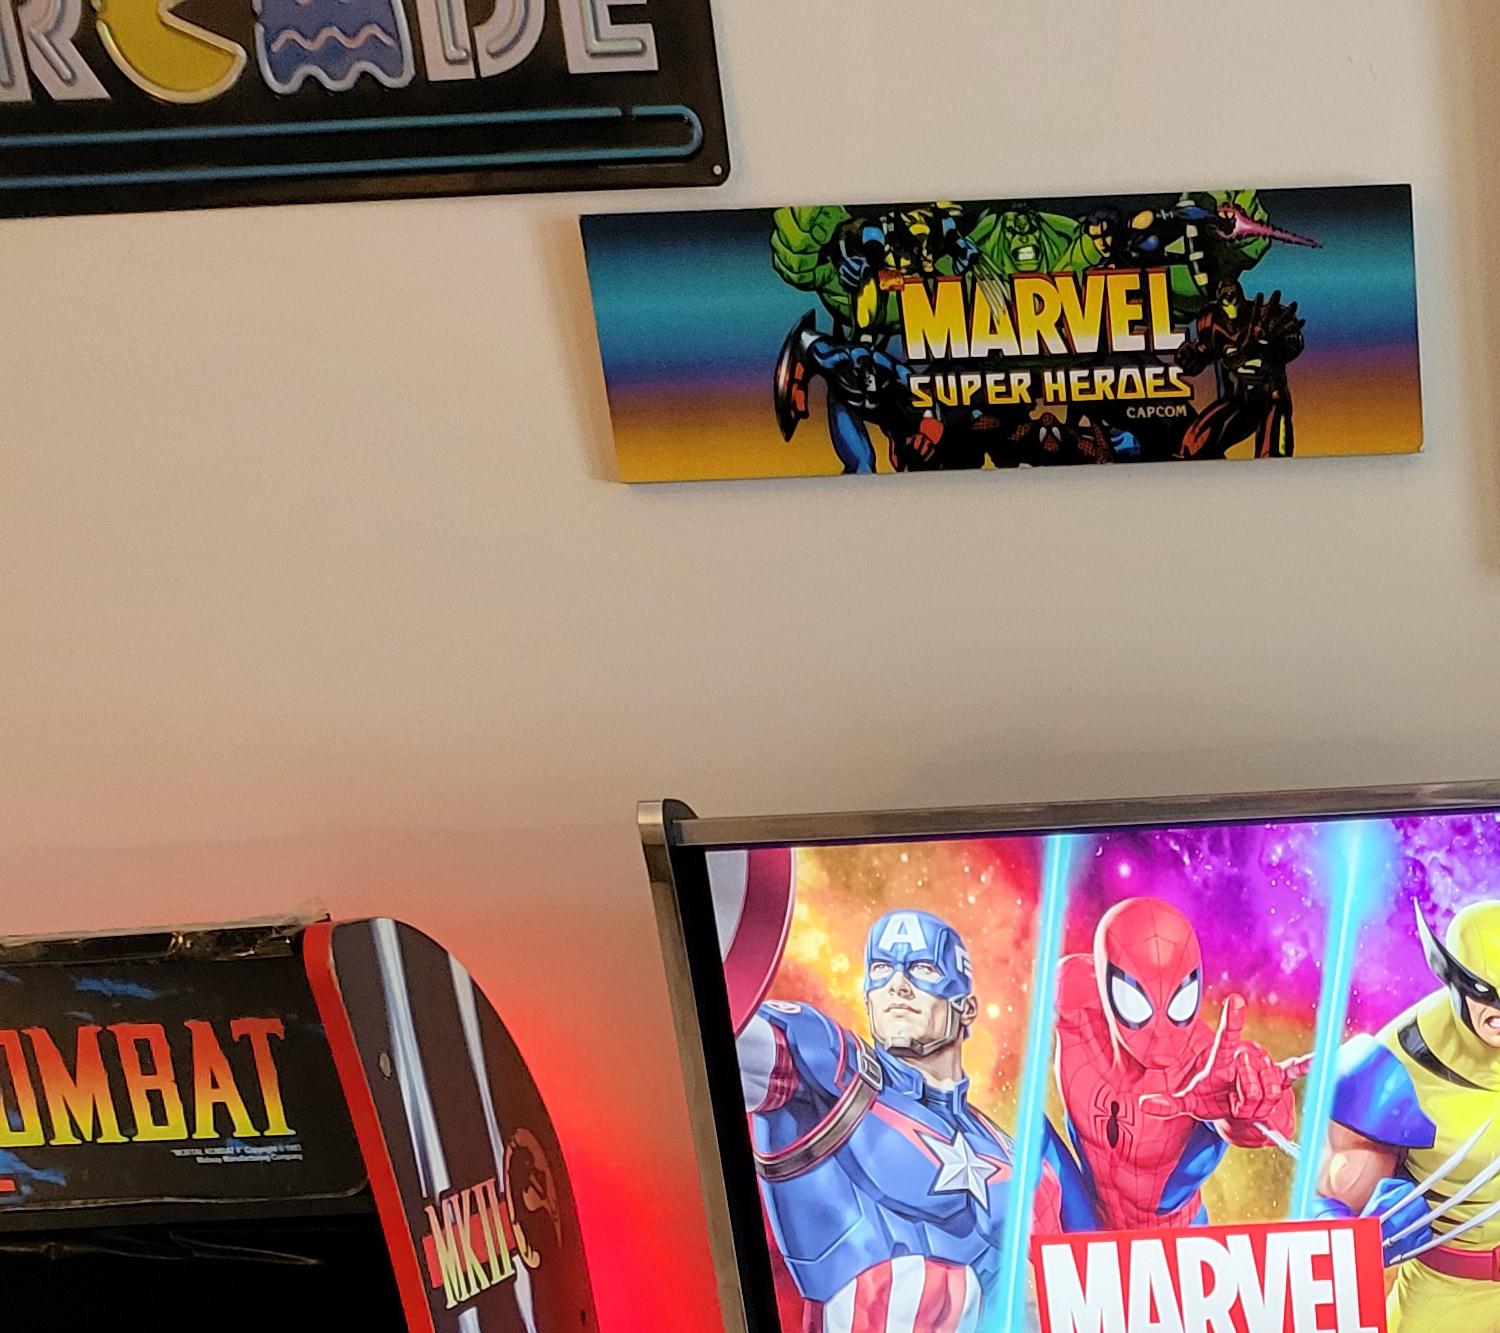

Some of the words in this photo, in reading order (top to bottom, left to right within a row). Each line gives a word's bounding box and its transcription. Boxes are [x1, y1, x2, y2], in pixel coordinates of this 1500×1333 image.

[901, 269, 1186, 360] MARVEL
[910, 371, 1031, 408] SUPER
[1043, 366, 1191, 402] HEROES
[1126, 405, 1187, 419] CAPCOM
